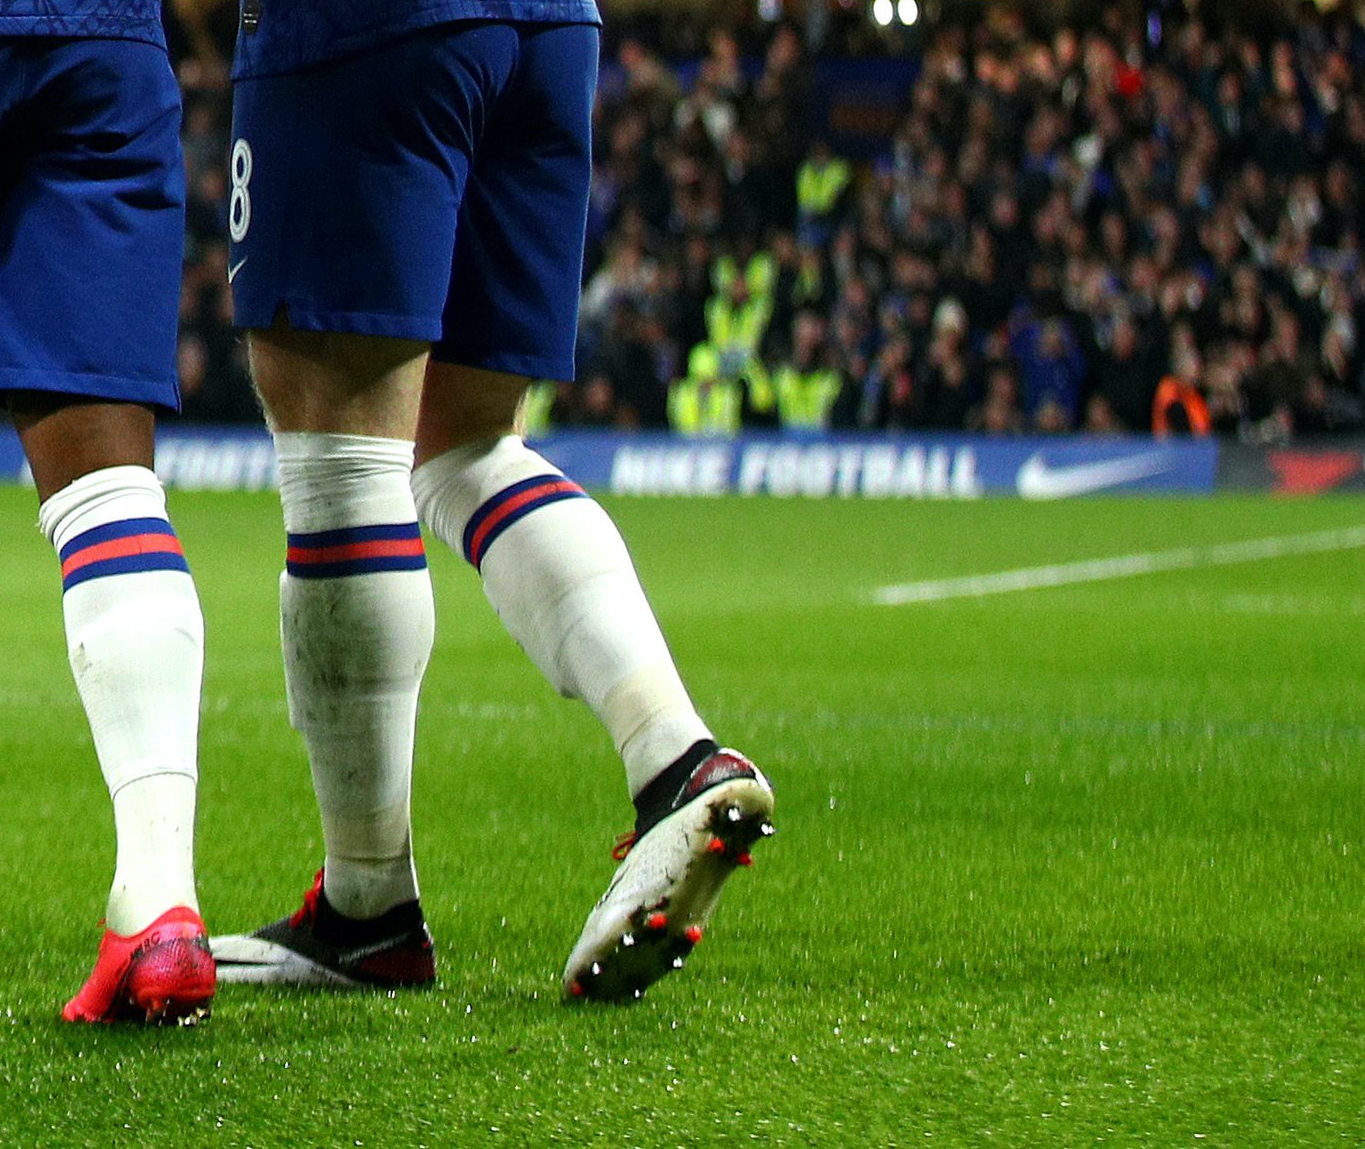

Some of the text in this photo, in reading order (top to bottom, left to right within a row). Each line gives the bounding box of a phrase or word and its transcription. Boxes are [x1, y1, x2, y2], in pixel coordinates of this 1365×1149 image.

[229, 138, 253, 243] 8
[611, 445, 983, 497] NIKE FOOTBALL
